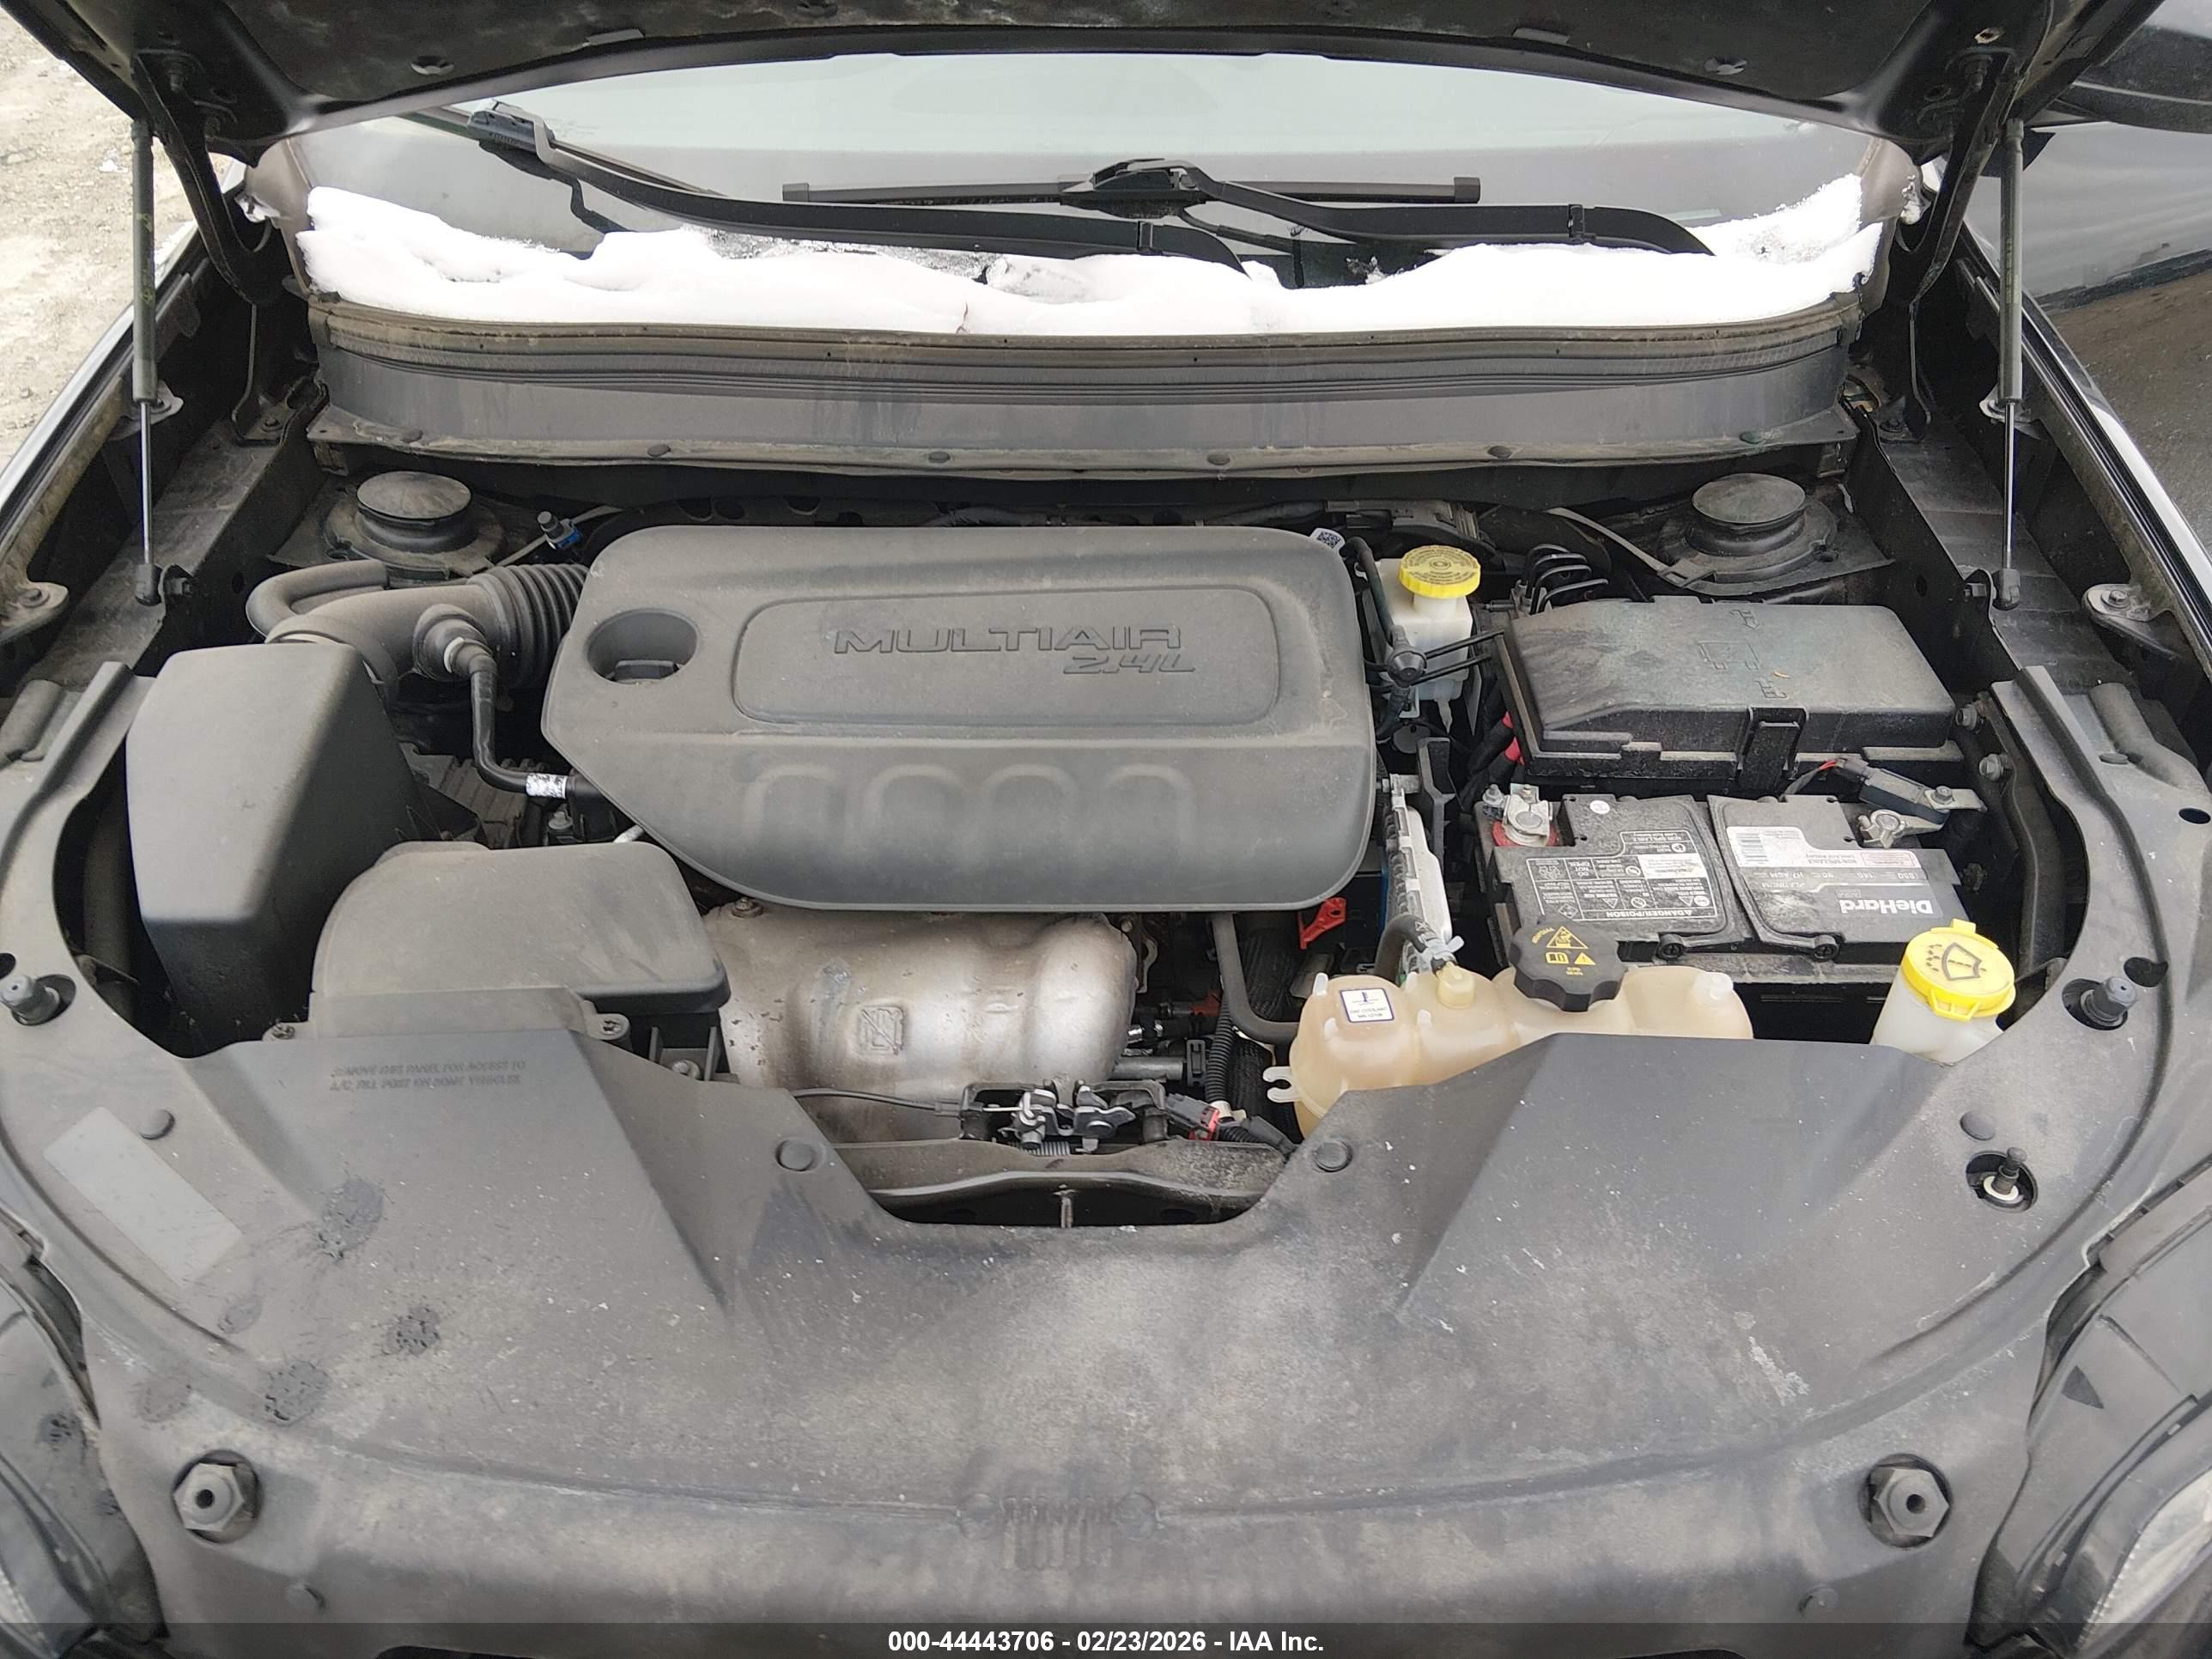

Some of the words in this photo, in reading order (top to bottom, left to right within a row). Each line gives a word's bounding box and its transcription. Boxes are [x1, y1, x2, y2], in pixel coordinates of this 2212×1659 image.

[833, 624, 1182, 654] MULTIAIR
[1063, 653, 1196, 674] 2.4L
[1839, 899, 1932, 914] DieHard
